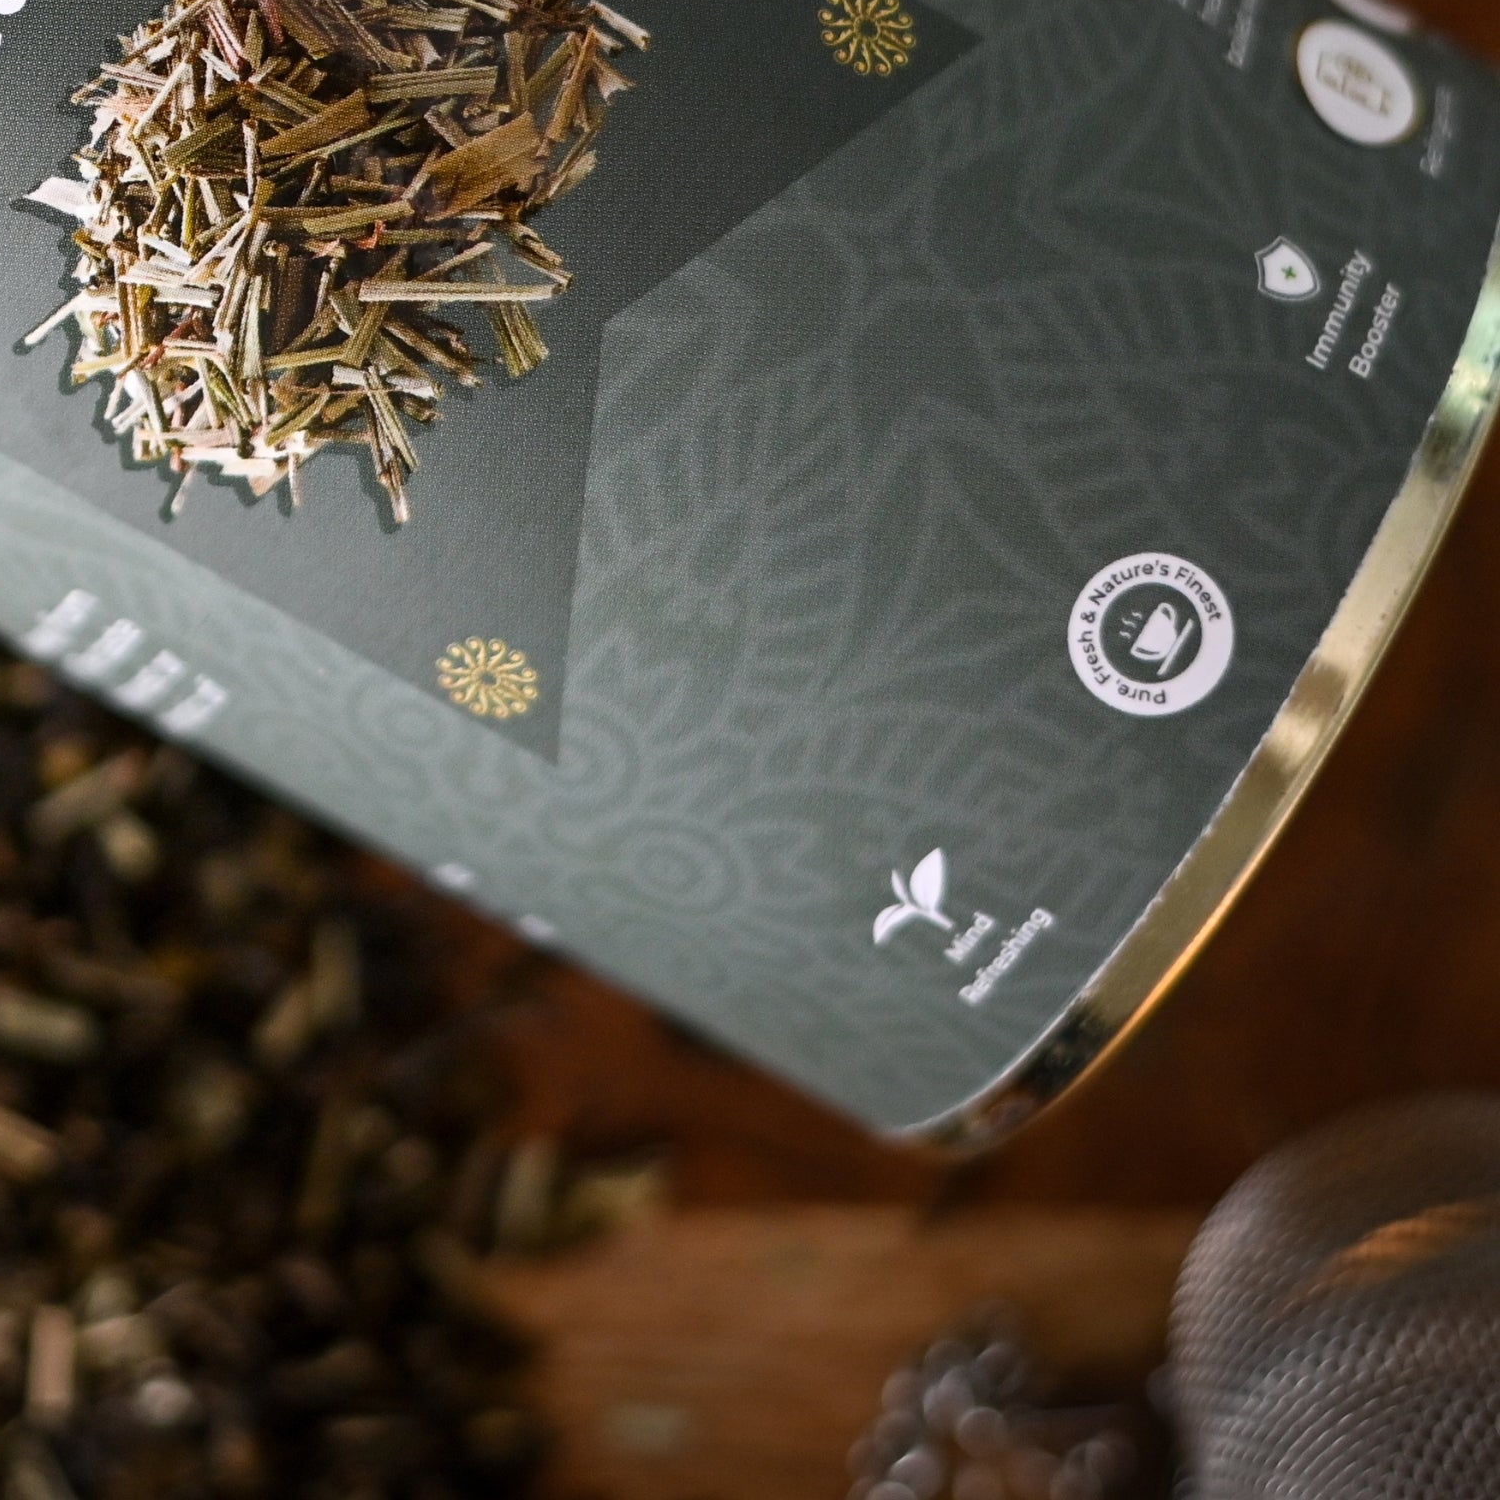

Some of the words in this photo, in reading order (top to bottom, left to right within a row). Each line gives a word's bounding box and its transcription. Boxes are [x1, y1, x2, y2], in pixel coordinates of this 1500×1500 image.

[1305, 250, 1372, 369] Immunity
[1348, 282, 1401, 378] Booster
[1088, 560, 1169, 606] Nature's
[1174, 566, 1223, 622] Finest
[1081, 611, 1096, 624] &
[1078, 630, 1111, 685] Fresh
[959, 909, 1053, 1004] Refreshing
